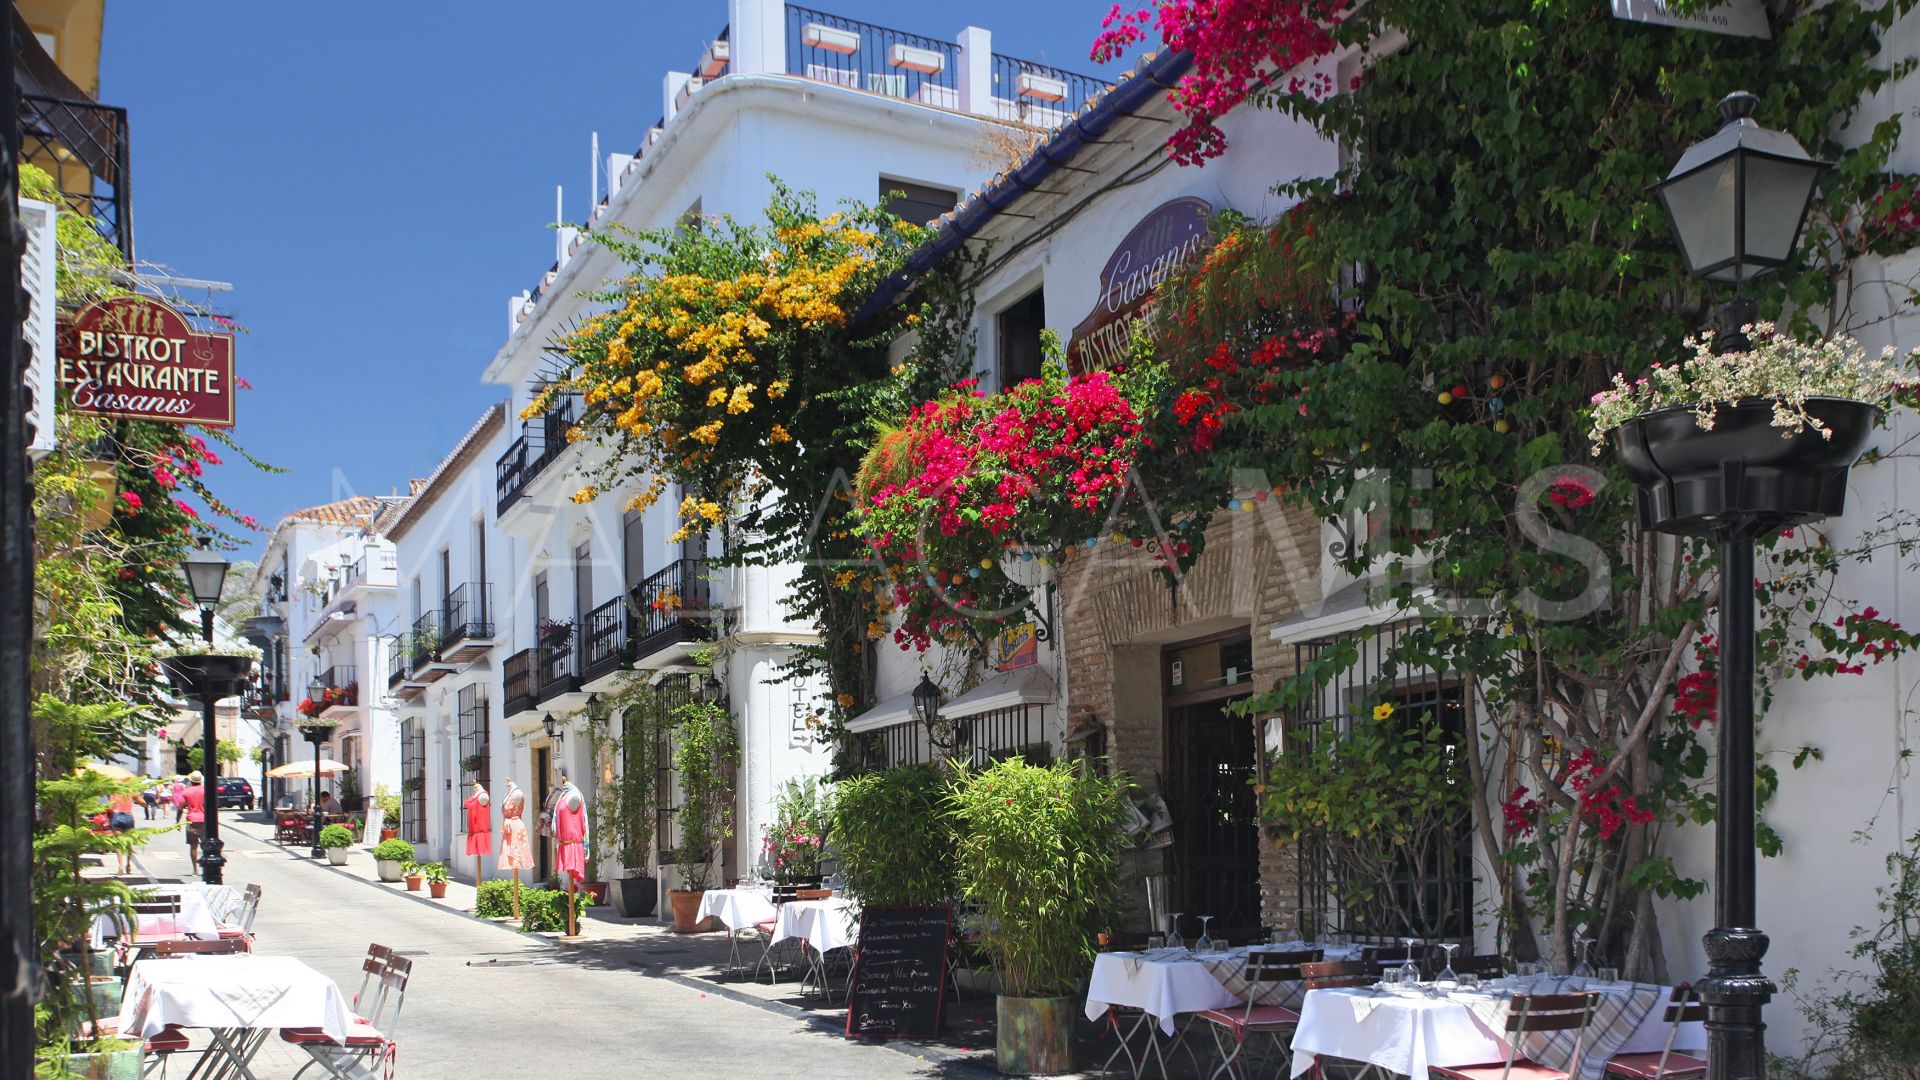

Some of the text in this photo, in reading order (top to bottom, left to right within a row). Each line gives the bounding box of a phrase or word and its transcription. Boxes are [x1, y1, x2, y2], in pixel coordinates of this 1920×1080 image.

[1712, 15, 1728, 26] 450
[1107, 224, 1200, 313] Casanis
[79, 330, 187, 364] BISTROT
[1079, 311, 1133, 374] BISTROT
[55, 357, 220, 394] ESTAURANTE
[71, 378, 196, 415] Casanis
[792, 672, 807, 731] OTEL
